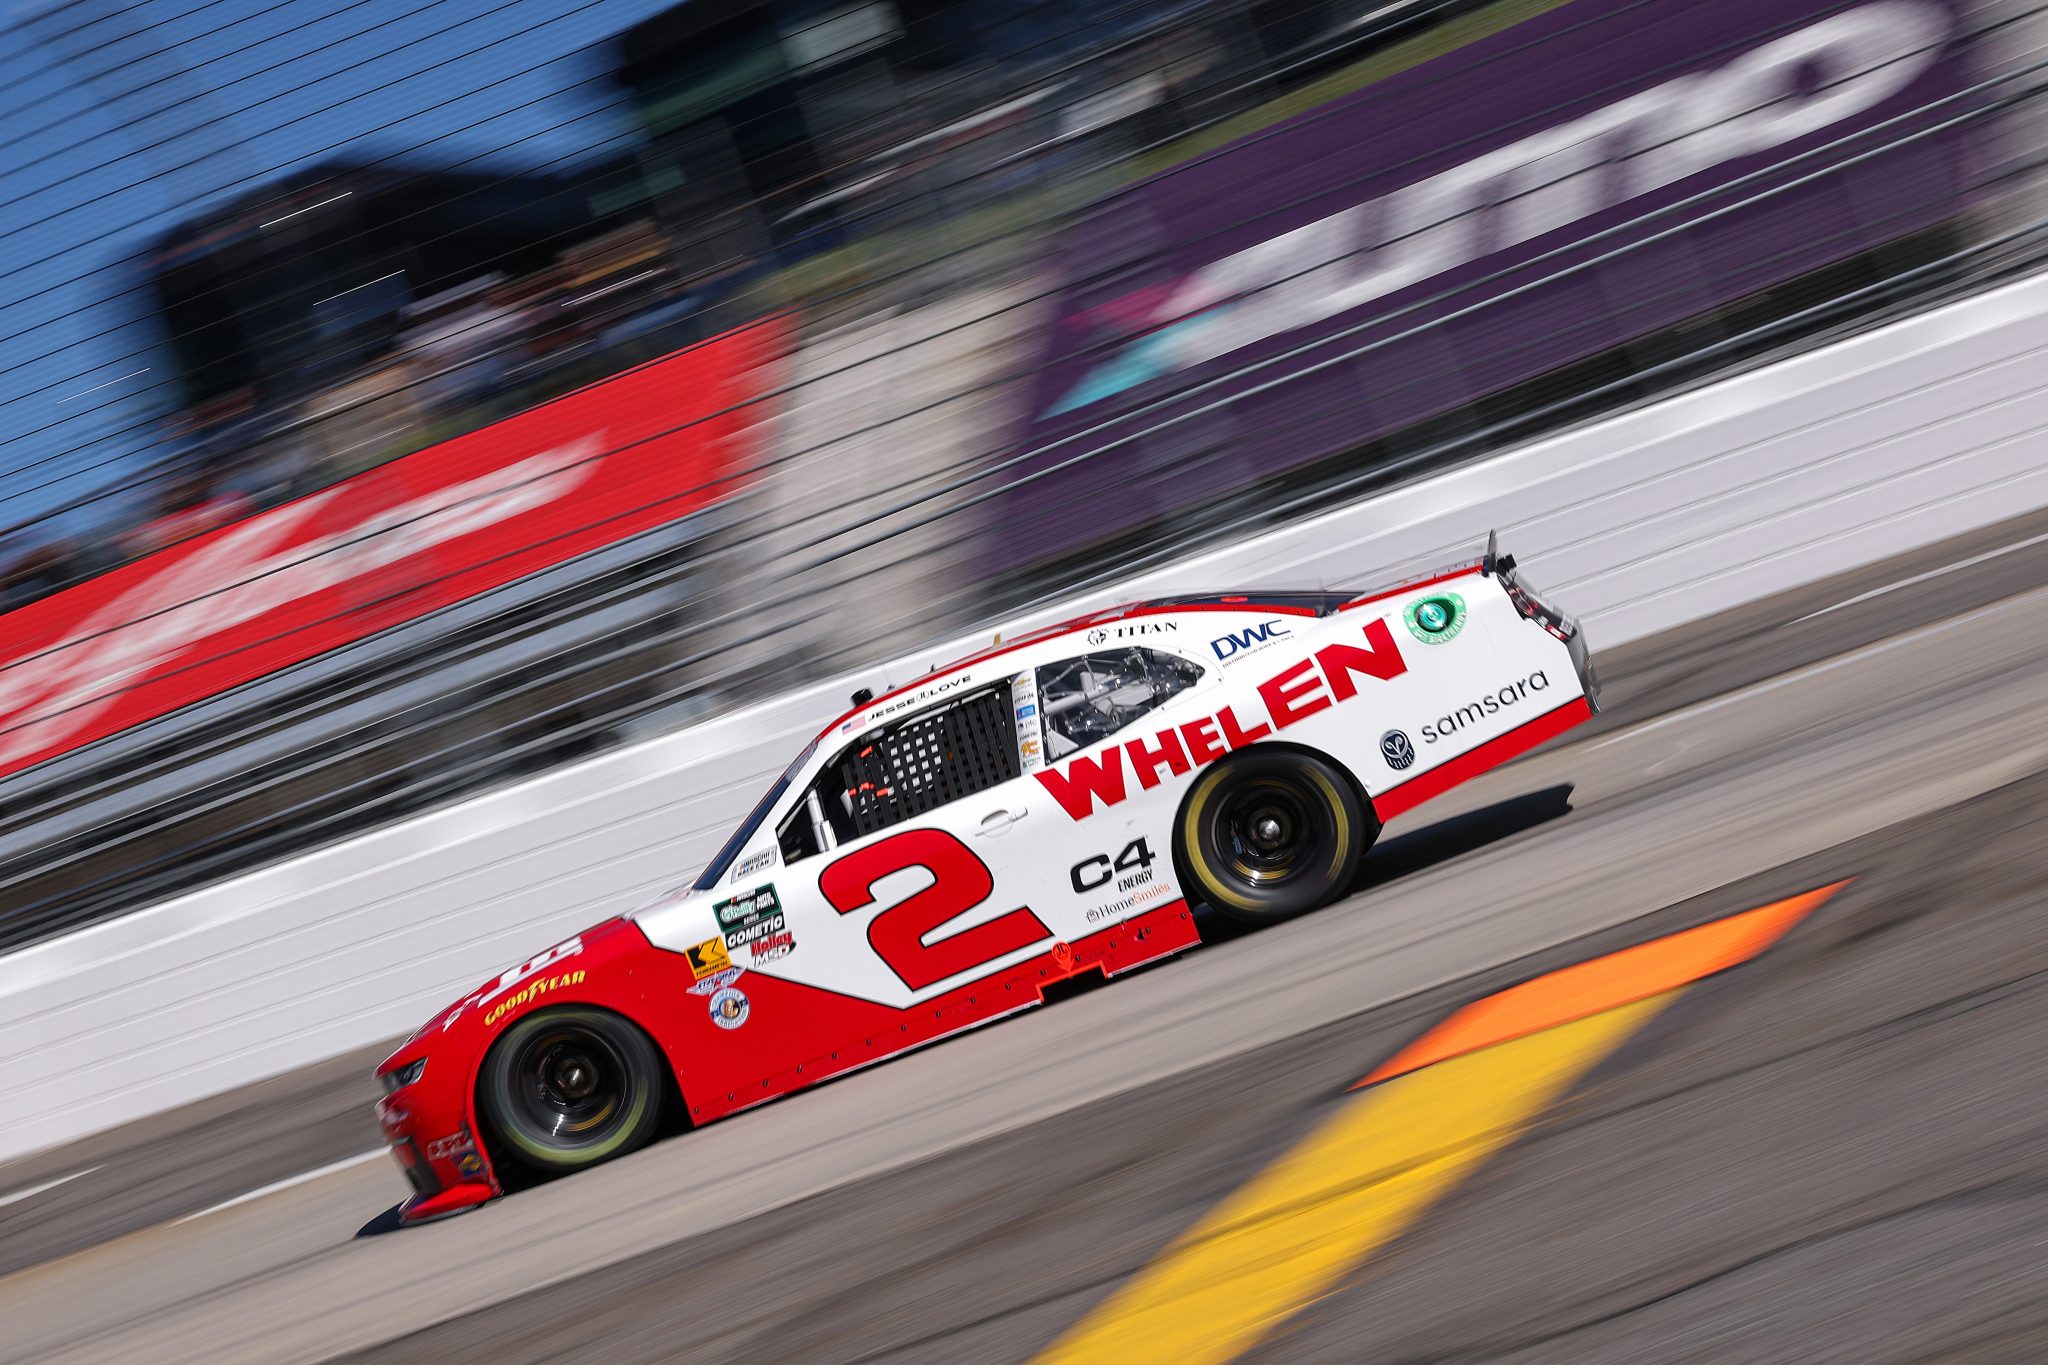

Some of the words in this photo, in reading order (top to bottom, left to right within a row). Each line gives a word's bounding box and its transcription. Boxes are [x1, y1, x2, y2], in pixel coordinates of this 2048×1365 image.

[1114, 621, 1178, 639] TITAN
[1210, 619, 1291, 661] DWC
[869, 698, 915, 721] JESSE
[930, 675, 971, 697] LOVE
[1033, 617, 1408, 822] WHELEN
[1421, 670, 1550, 744] samsara
[1070, 835, 1156, 894] C4
[1117, 868, 1153, 893] ENERGY
[818, 828, 1054, 993] 2
[751, 930, 793, 957] Holley
[484, 969, 586, 1026] GOODYEAR
